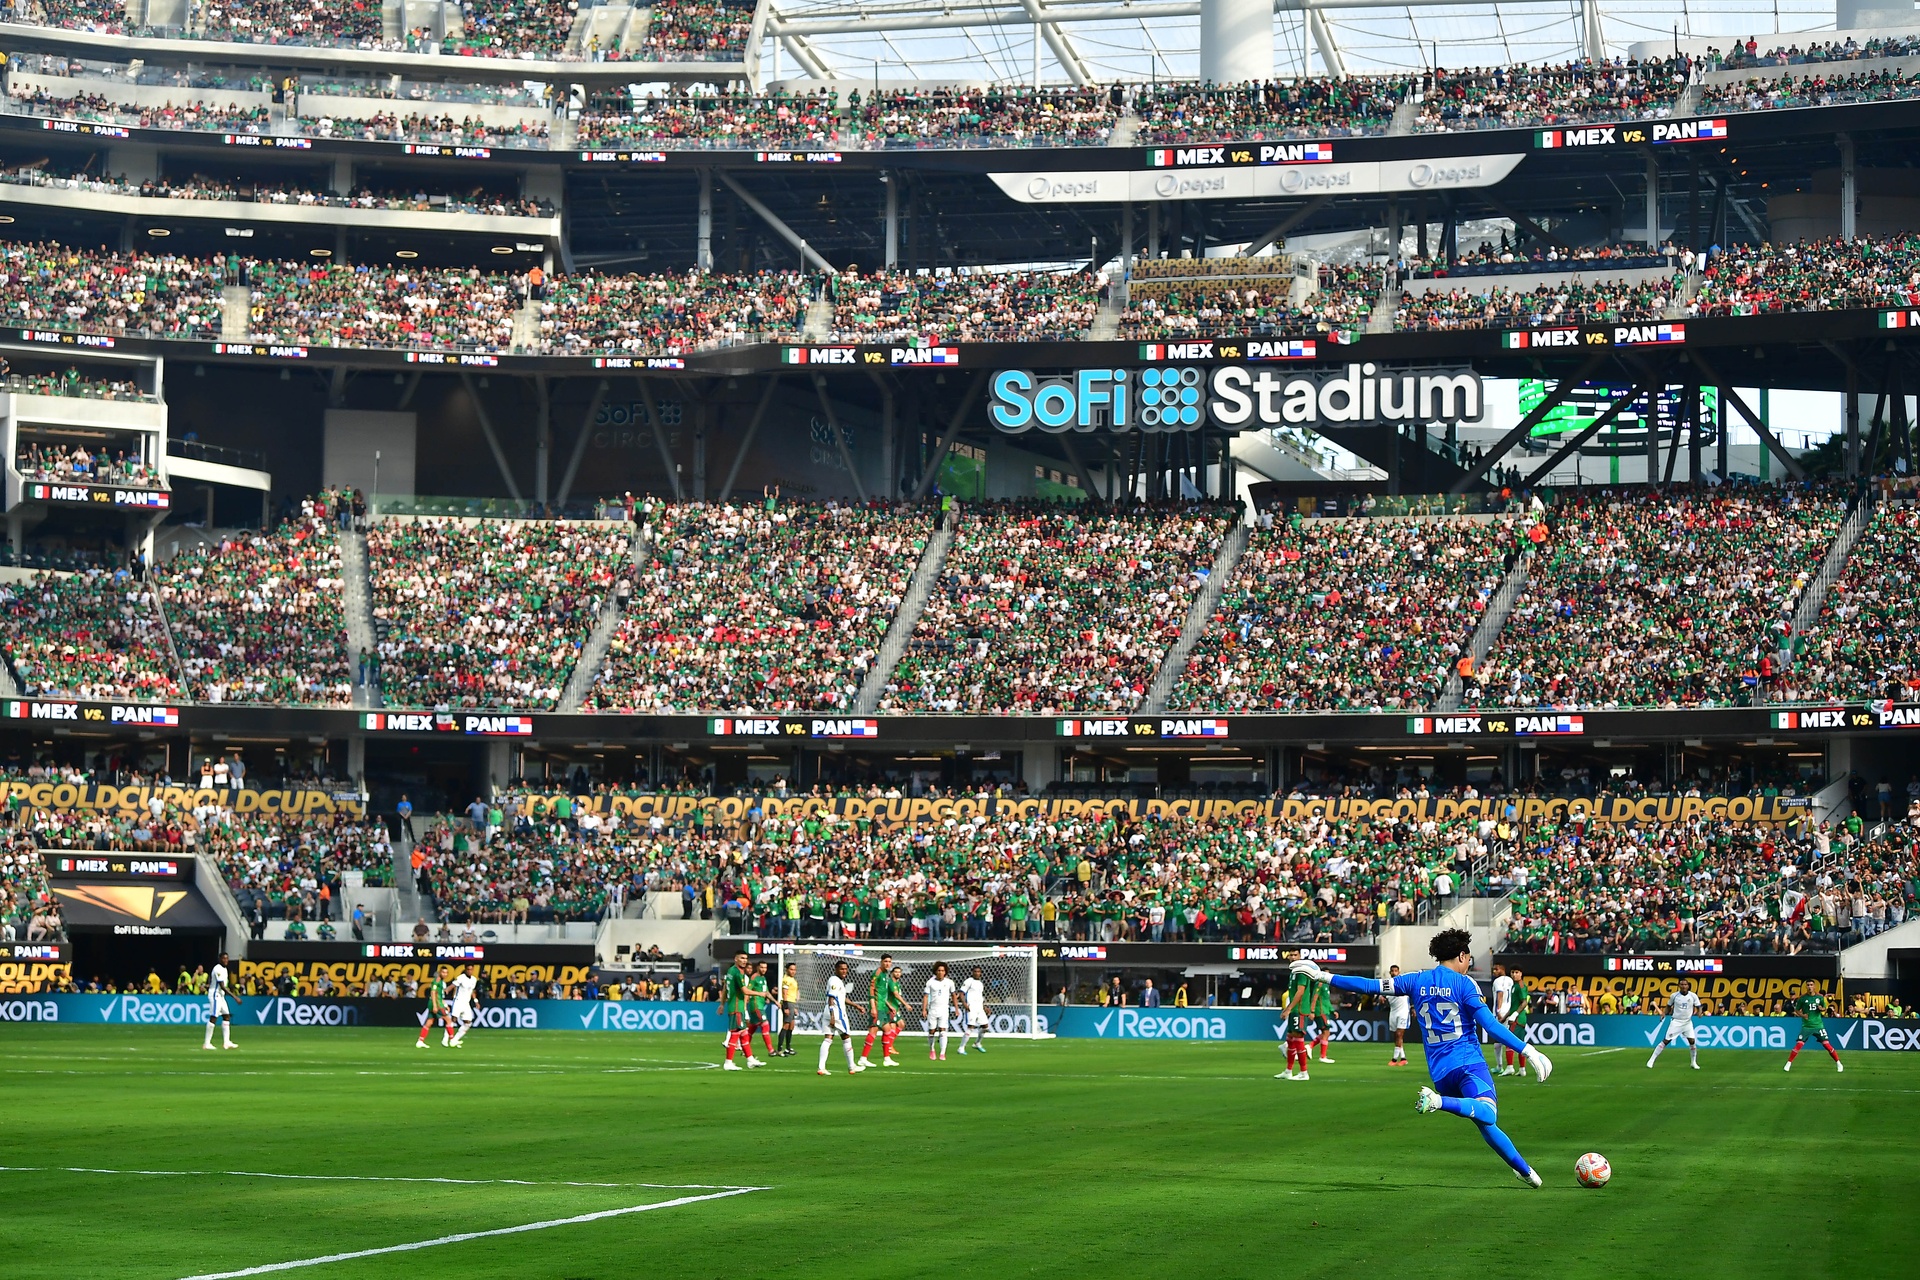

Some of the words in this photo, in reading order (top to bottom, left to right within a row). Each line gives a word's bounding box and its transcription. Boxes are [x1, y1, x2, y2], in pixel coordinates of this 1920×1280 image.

[54, 122, 78, 132] MEX
[94, 125, 116, 135] PAN
[1566, 128, 1616, 147] MEX
[1652, 121, 1697, 141] PAN
[235, 135, 260, 145] MEX
[276, 138, 298, 147] PAN
[415, 146, 440, 155] MEX
[455, 147, 477, 157] PAN
[592, 152, 616, 161] MEX
[631, 152, 653, 161] PAN
[767, 153, 792, 162] MEX
[806, 153, 828, 162] PAN
[1176, 147, 1225, 165] MEX
[1260, 144, 1304, 162] PAN
[1304, 171, 1351, 189] pepsi
[1433, 164, 1481, 184] pepsi
[1052, 180, 1098, 197] pepsi
[1180, 176, 1225, 195] pepsi
[34, 332, 60, 343] MEX
[77, 335, 100, 346] PAN
[1531, 330, 1580, 347] MEX
[1614, 326, 1657, 343] PAN
[227, 343, 253, 355] MEX
[270, 346, 293, 357] PAN
[810, 348, 856, 364] MEX
[891, 348, 932, 364] PAN
[1167, 343, 1214, 360] MEX
[1247, 341, 1289, 357] PAN
[418, 353, 444, 363] MEX
[460, 355, 483, 365] PAN
[606, 358, 632, 368] MEX
[647, 358, 670, 368] PAN
[993, 368, 1127, 427] SoFi
[1212, 362, 1478, 424] Stadium
[593, 432, 681, 448] CIRCE
[51, 486, 89, 501] MEX
[114, 490, 148, 505] PAN
[31, 703, 78, 720] MEX
[111, 706, 152, 722] PAN
[1801, 711, 1846, 728] MEX
[1879, 708, 1920, 725] PAN
[387, 714, 433, 730] MEX
[465, 716, 506, 732] PAN
[735, 720, 780, 735] MEX
[811, 720, 851, 735] PAN
[1084, 720, 1129, 736] MEX
[1161, 720, 1201, 735] PAN
[1435, 717, 1482, 733] MEX
[1515, 716, 1556, 732] PAN
[76, 860, 108, 872] MEX
[130, 861, 159, 873] PAN
[14, 946, 42, 957] PAN
[381, 945, 414, 957] MEX
[436, 946, 465, 958] PAN
[1060, 946, 1089, 958] PAN
[1246, 948, 1278, 960] MEX
[1300, 948, 1328, 960] PAN
[1622, 959, 1654, 971] MEX
[1676, 958, 1704, 970] PAN
[0, 1000, 58, 1022] xona
[121, 995, 212, 1023] Rexona
[276, 997, 358, 1025] Rexon
[602, 1002, 704, 1031] Rexona
[1118, 1009, 1226, 1038] Rexona
[1419, 1002, 1463, 1044] 13
[1524, 1022, 1596, 1046] xona
[1863, 1019, 1920, 1050] Rex
